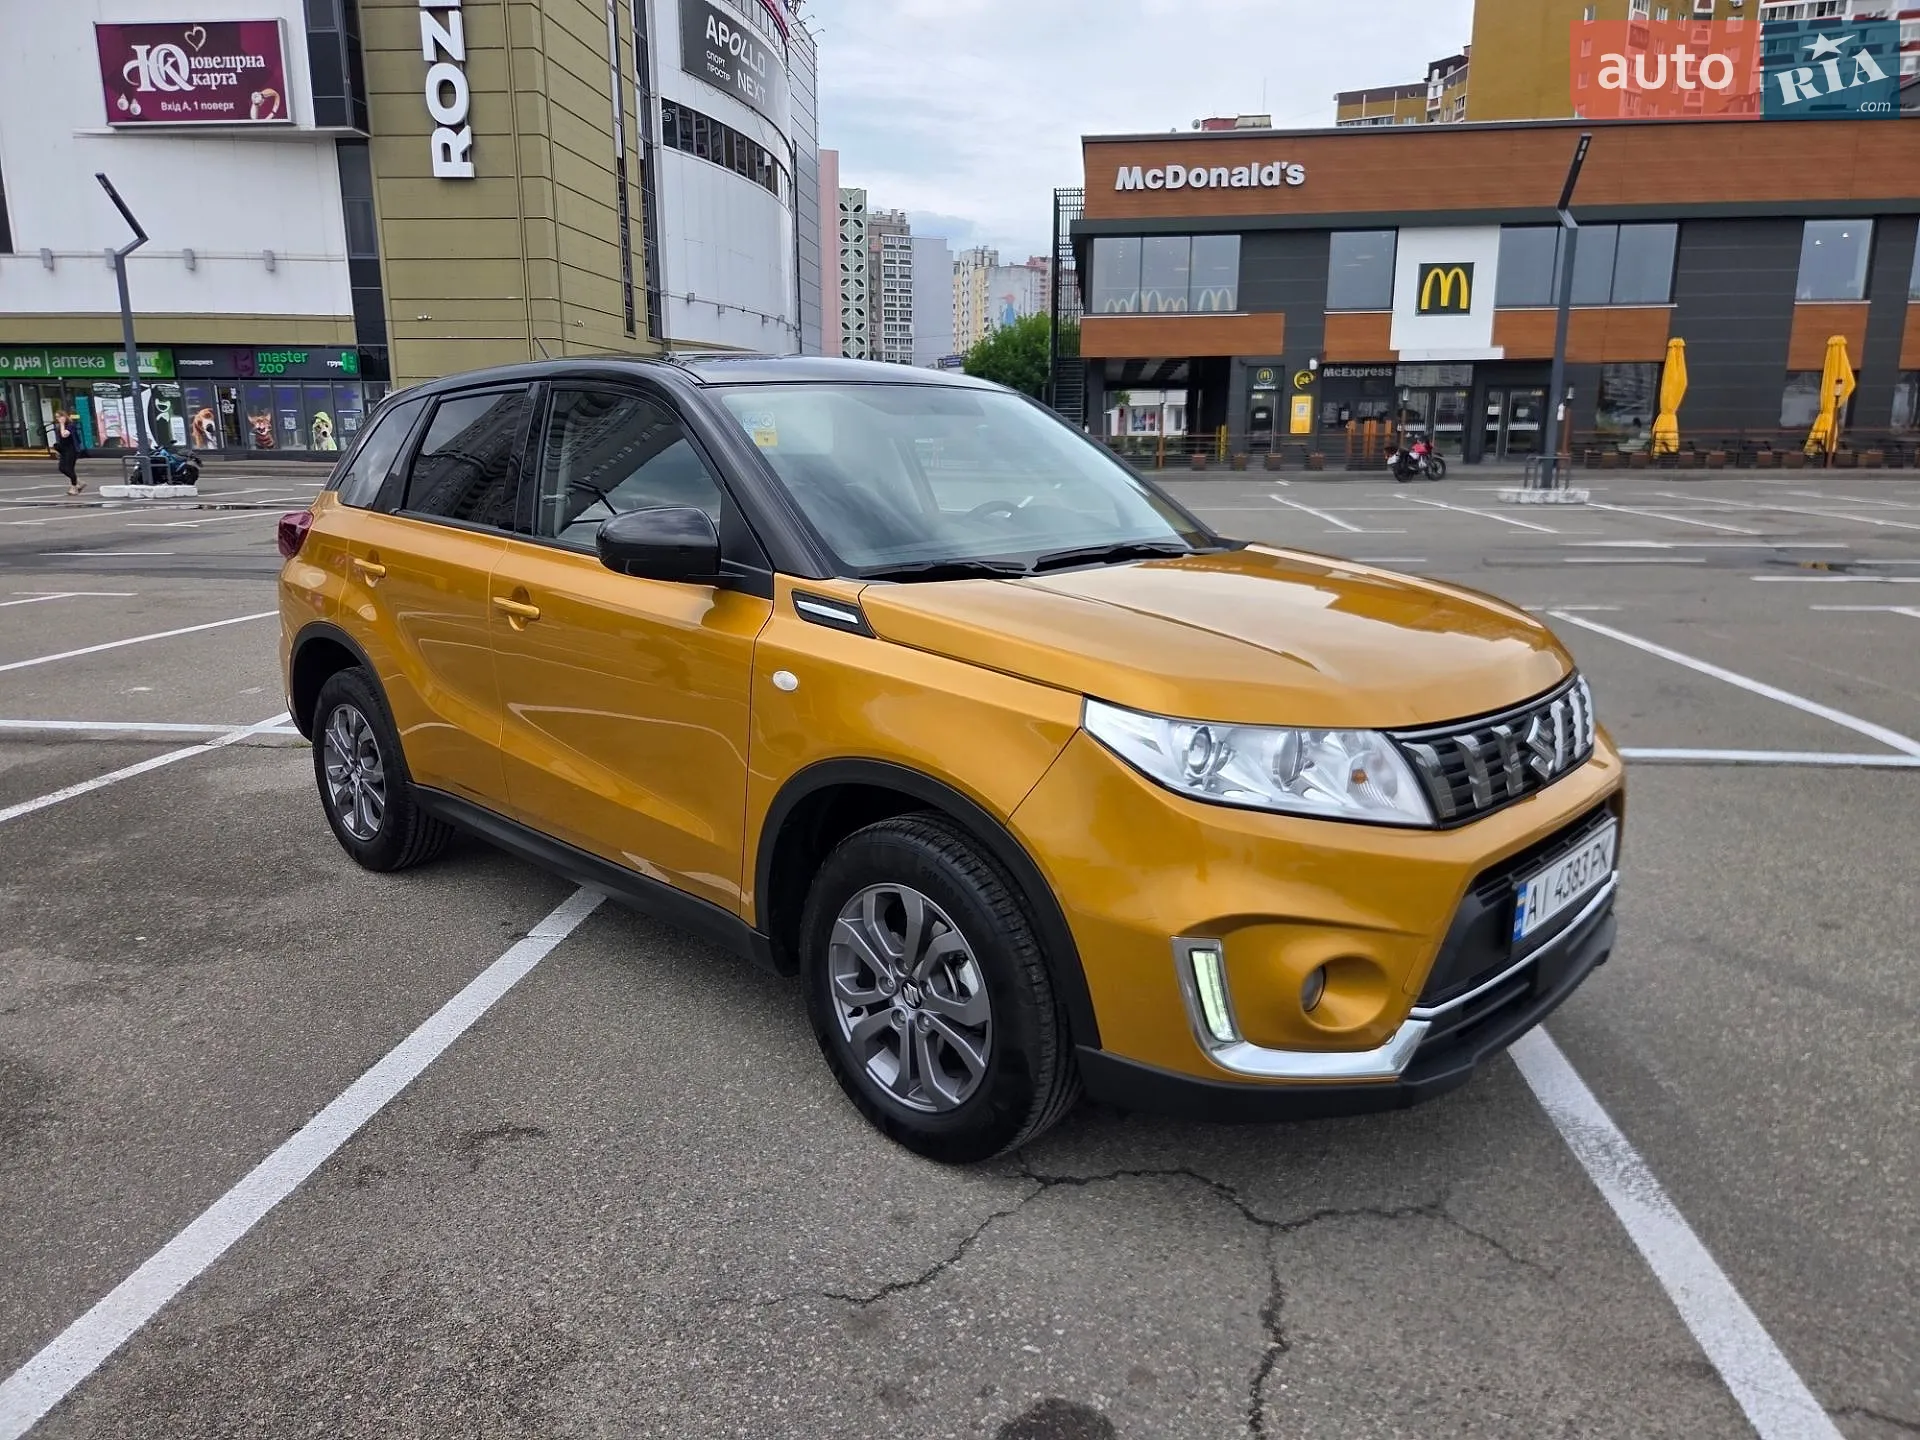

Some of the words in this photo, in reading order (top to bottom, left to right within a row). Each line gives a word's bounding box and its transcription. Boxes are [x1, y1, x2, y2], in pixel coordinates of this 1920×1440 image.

[705, 14, 766, 78] APOLLO
[190, 54, 266, 72] ювелірна
[192, 72, 238, 90] карта
[418, 0, 476, 179] ROZ
[737, 69, 766, 105] NEXT
[161, 101, 182, 113] Вхід
[194, 101, 199, 110] 1
[200, 101, 235, 112] поверх
[1114, 161, 1306, 191] McDonald's
[13, 355, 42, 371] дня
[52, 354, 106, 369] аптека
[257, 350, 308, 363] master
[258, 363, 285, 374] zoo
[1323, 367, 1393, 378] McExpress
